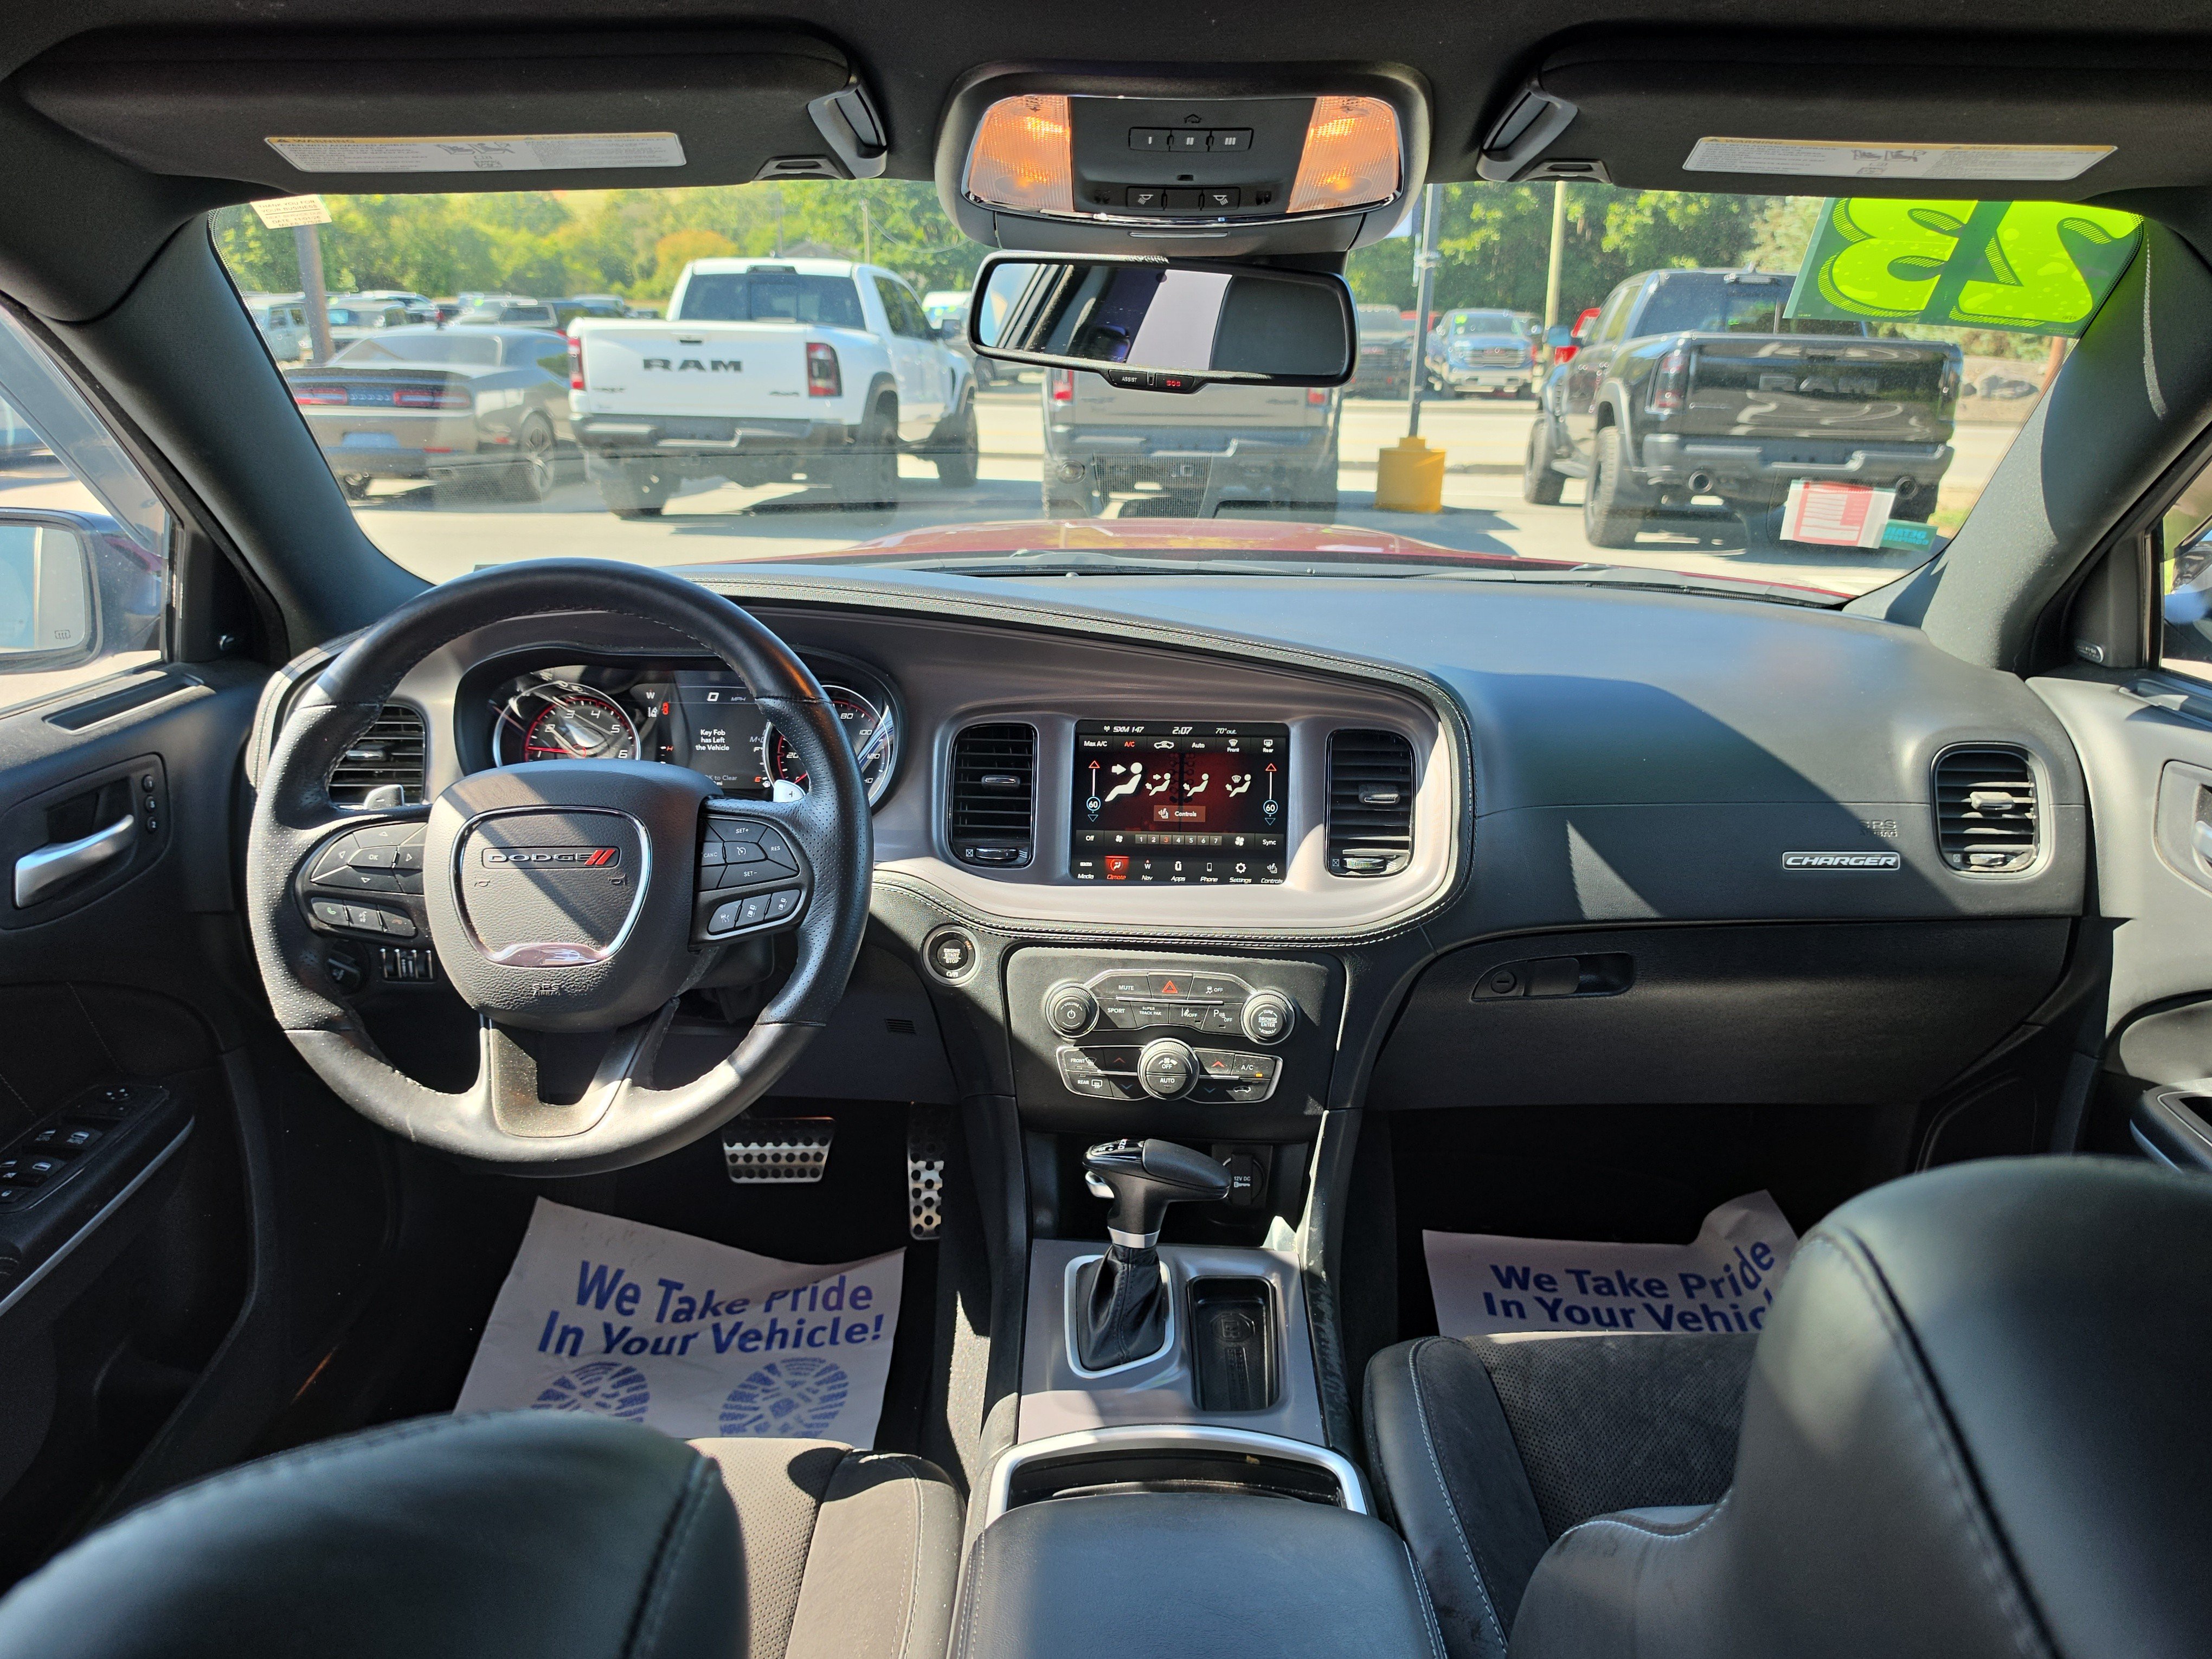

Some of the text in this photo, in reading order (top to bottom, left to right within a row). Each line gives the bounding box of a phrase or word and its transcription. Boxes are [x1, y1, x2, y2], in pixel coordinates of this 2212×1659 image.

[643, 358, 744, 372] RAM
[1758, 373, 1877, 395] RAM
[707, 692, 719, 702] 0
[590, 710, 600, 718] 4
[610, 724, 620, 734] 5
[1172, 726, 1193, 735] 2:07
[618, 750, 628, 758] 6
[488, 852, 595, 862] DODGE
[1785, 856, 1897, 866] CHARGER
[1213, 1009, 1219, 1017] P
[1489, 1241, 1774, 1300] We Take Pride
[576, 1260, 873, 1324] We Take Pride
[1482, 1289, 1773, 1333] In Your Vehic
[537, 1310, 884, 1356] In Your Vehicle!
